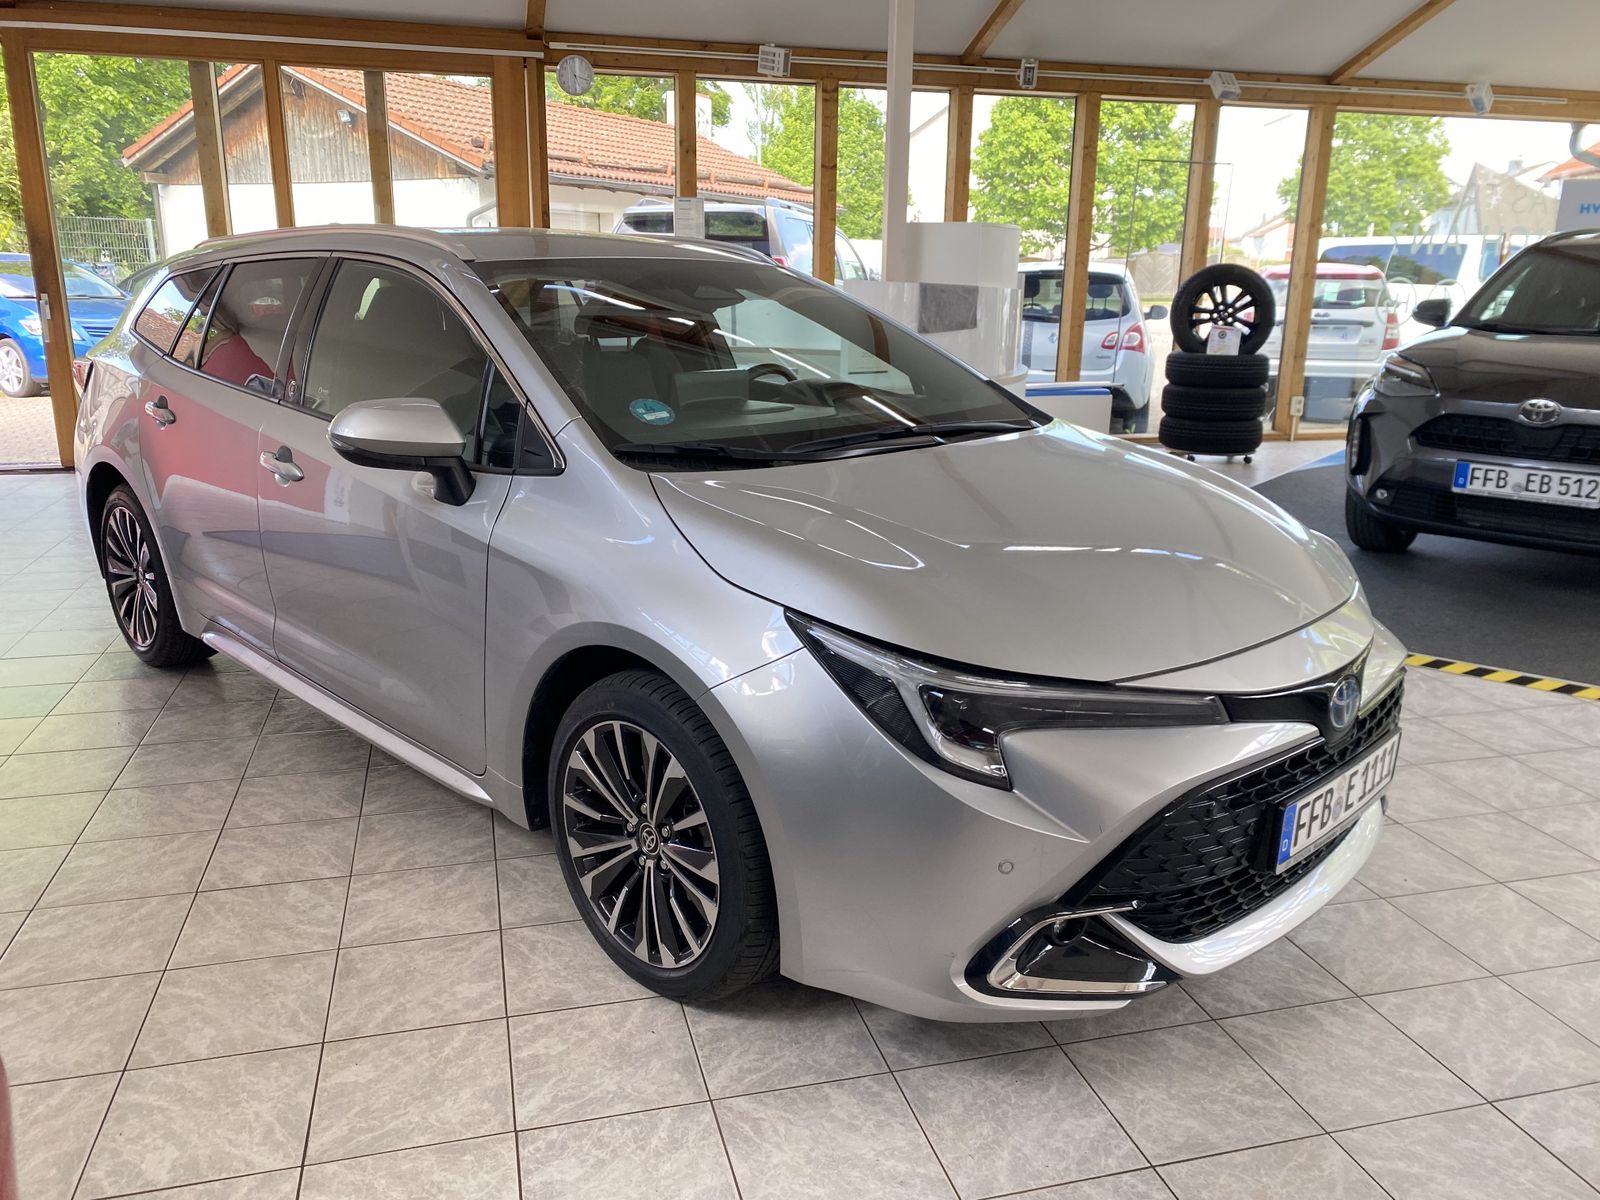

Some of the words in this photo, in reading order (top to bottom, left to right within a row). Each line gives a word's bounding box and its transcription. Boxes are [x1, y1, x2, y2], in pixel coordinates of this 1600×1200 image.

[1469, 467, 1509, 489] FFB
[1524, 472, 1553, 494] EB
[1557, 476, 1599, 499] 512
[1292, 786, 1335, 848] FFB
